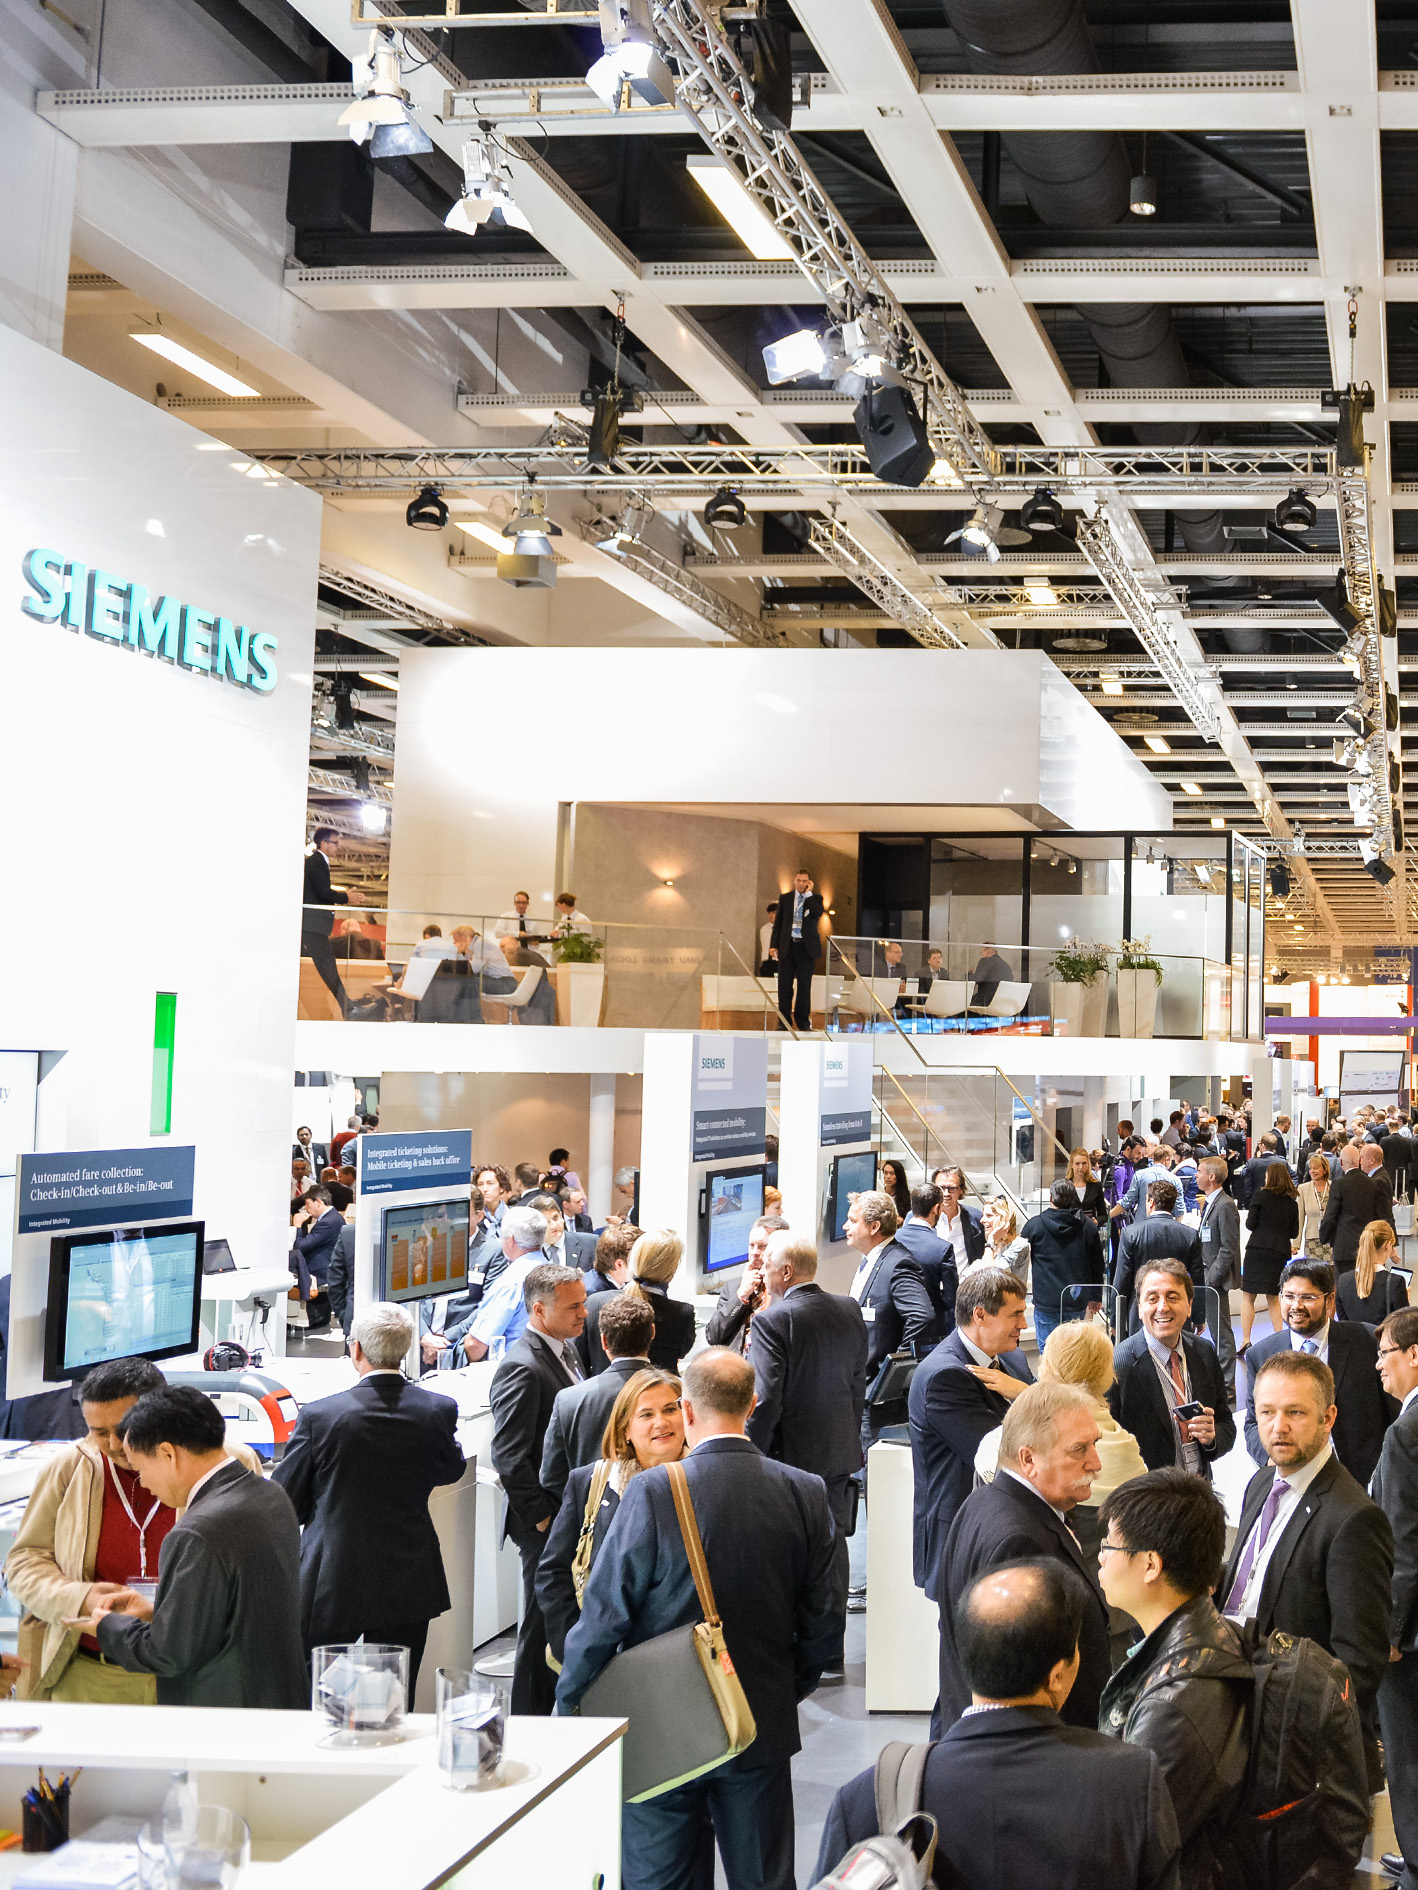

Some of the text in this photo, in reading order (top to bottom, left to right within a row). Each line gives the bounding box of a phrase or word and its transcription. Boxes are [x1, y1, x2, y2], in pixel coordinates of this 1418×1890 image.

[22, 549, 278, 696] SIEMENS
[702, 1058, 726, 1069] SIEMENS
[826, 1060, 843, 1070] SIEMENS
[367, 1145, 448, 1159] Integrated ticketing solutions:
[367, 1161, 386, 1171] Mobile
[387, 1159, 412, 1170] ticketing
[418, 1157, 432, 1166] sales
[445, 1155, 460, 1164] office
[31, 1166, 144, 1184] Automated fare collection:
[29, 1217, 71, 1229] Integrated Mobility
